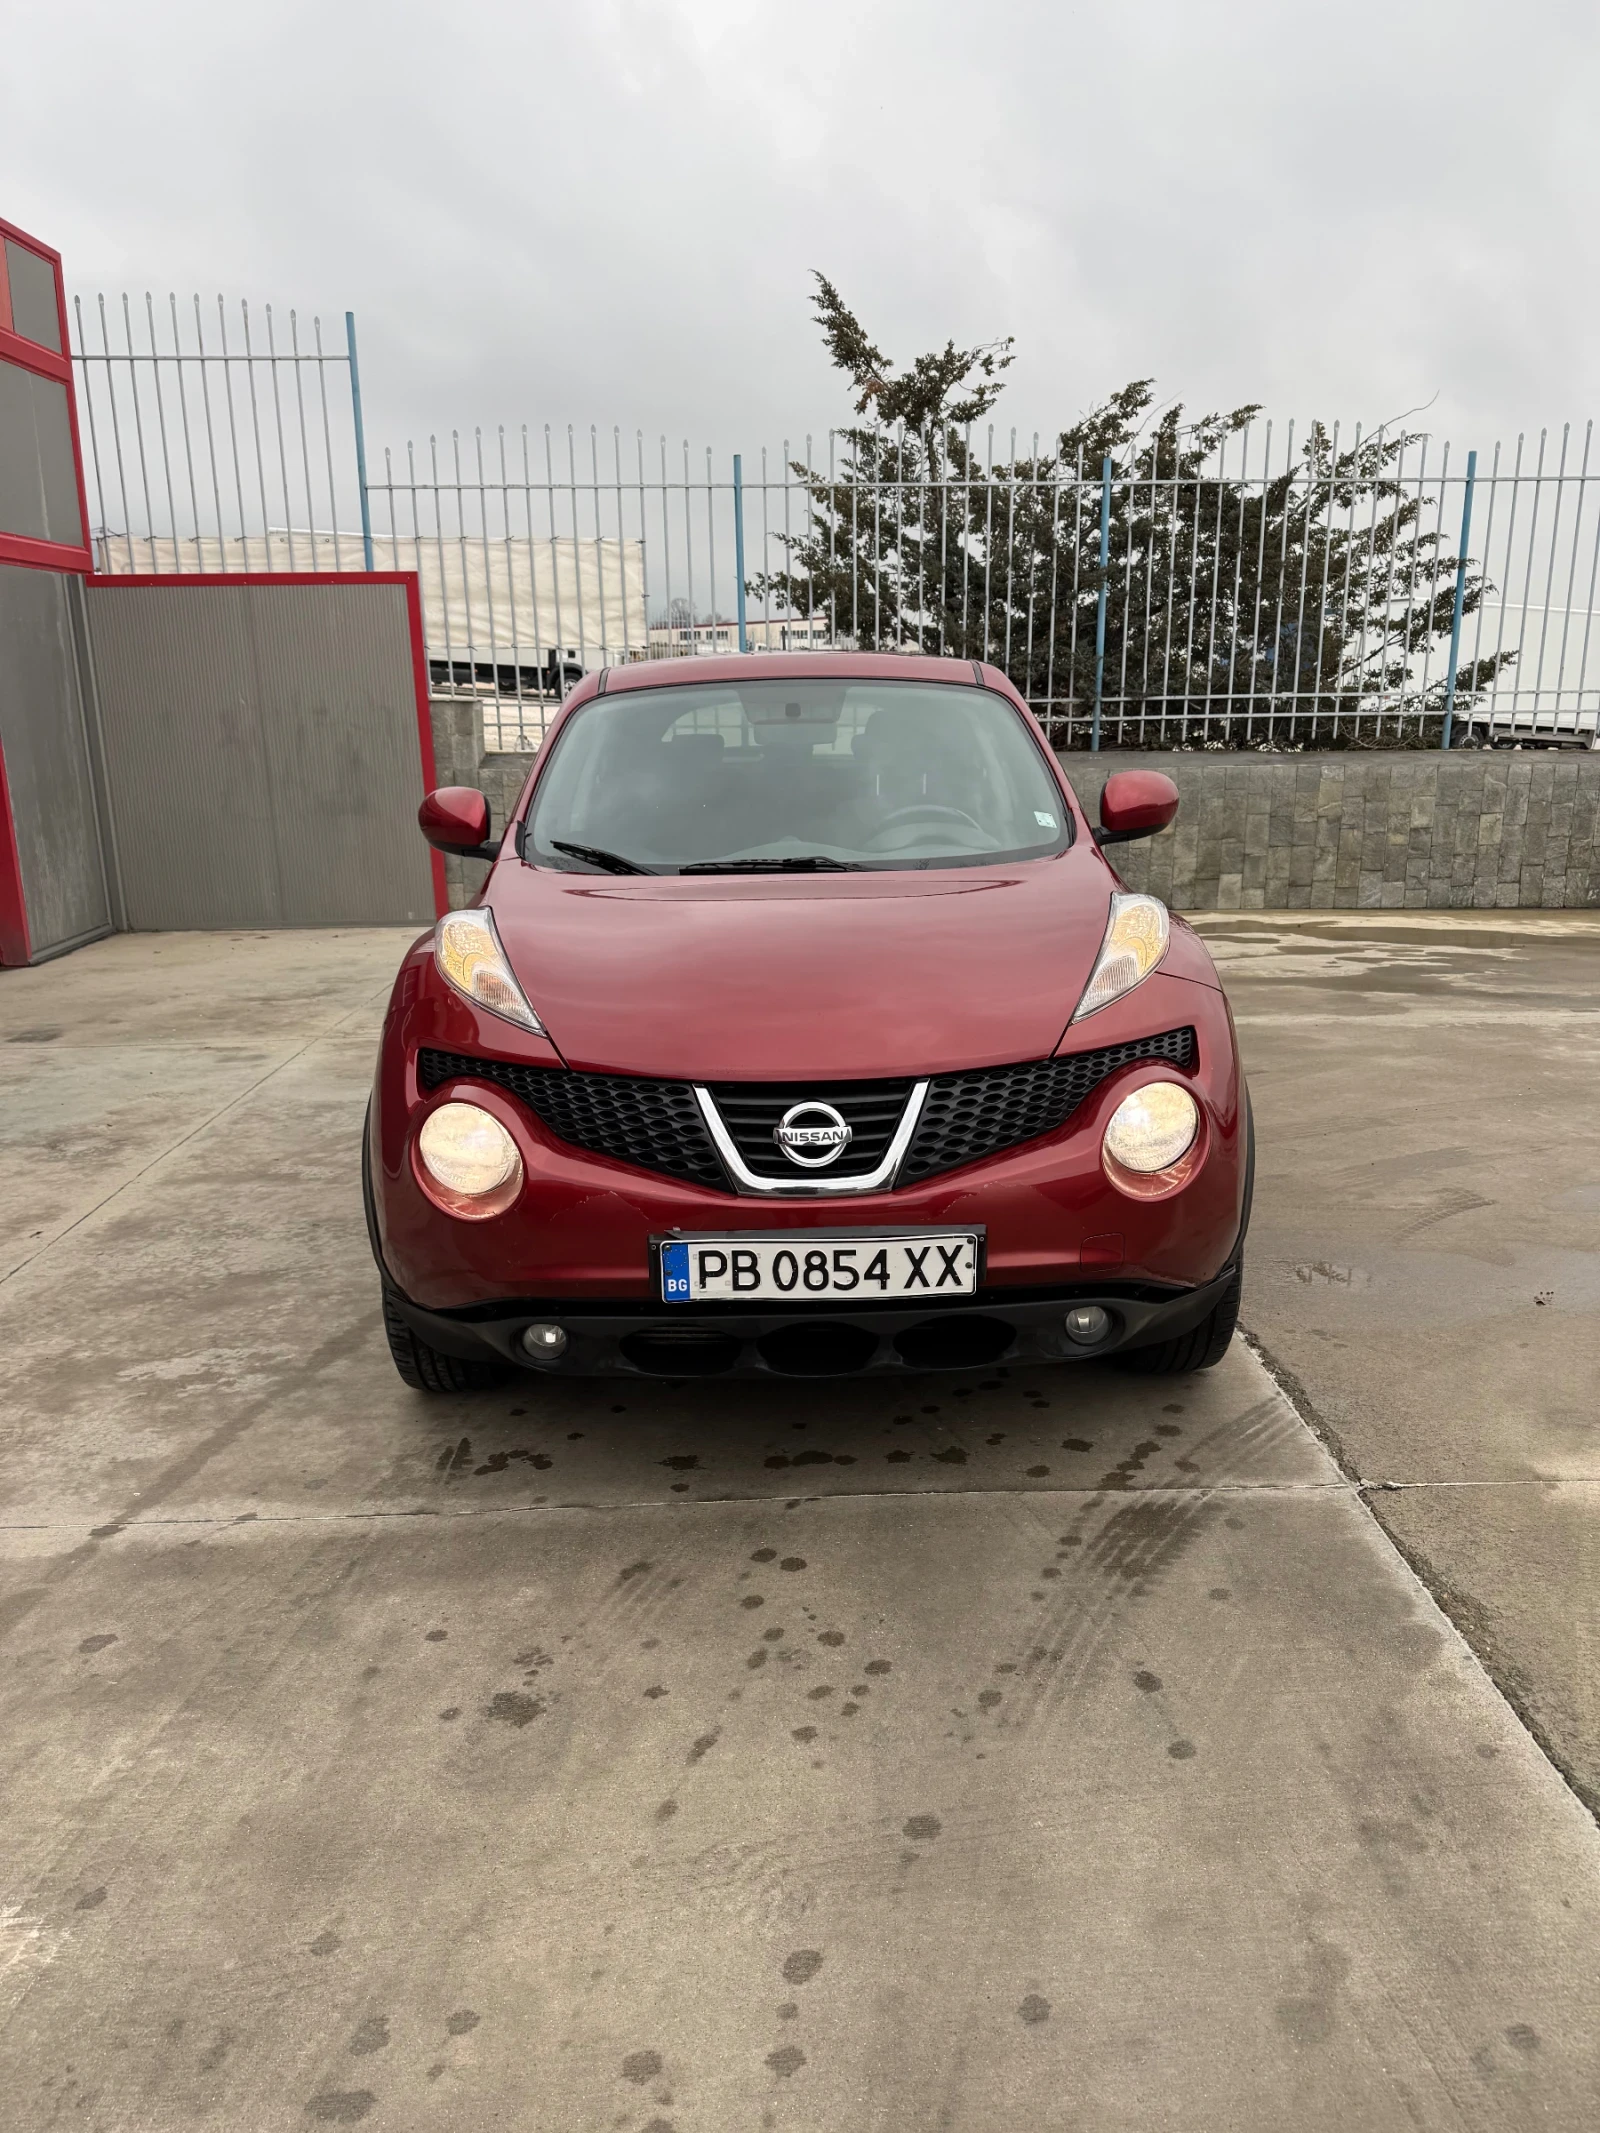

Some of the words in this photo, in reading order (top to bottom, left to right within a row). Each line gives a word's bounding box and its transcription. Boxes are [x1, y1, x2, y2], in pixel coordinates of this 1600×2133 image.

[782, 1130, 844, 1142] NISSAN
[698, 1249, 761, 1291] PB
[772, 1248, 890, 1291] 0854
[903, 1244, 964, 1289] XX
[667, 1277, 688, 1292] BG
